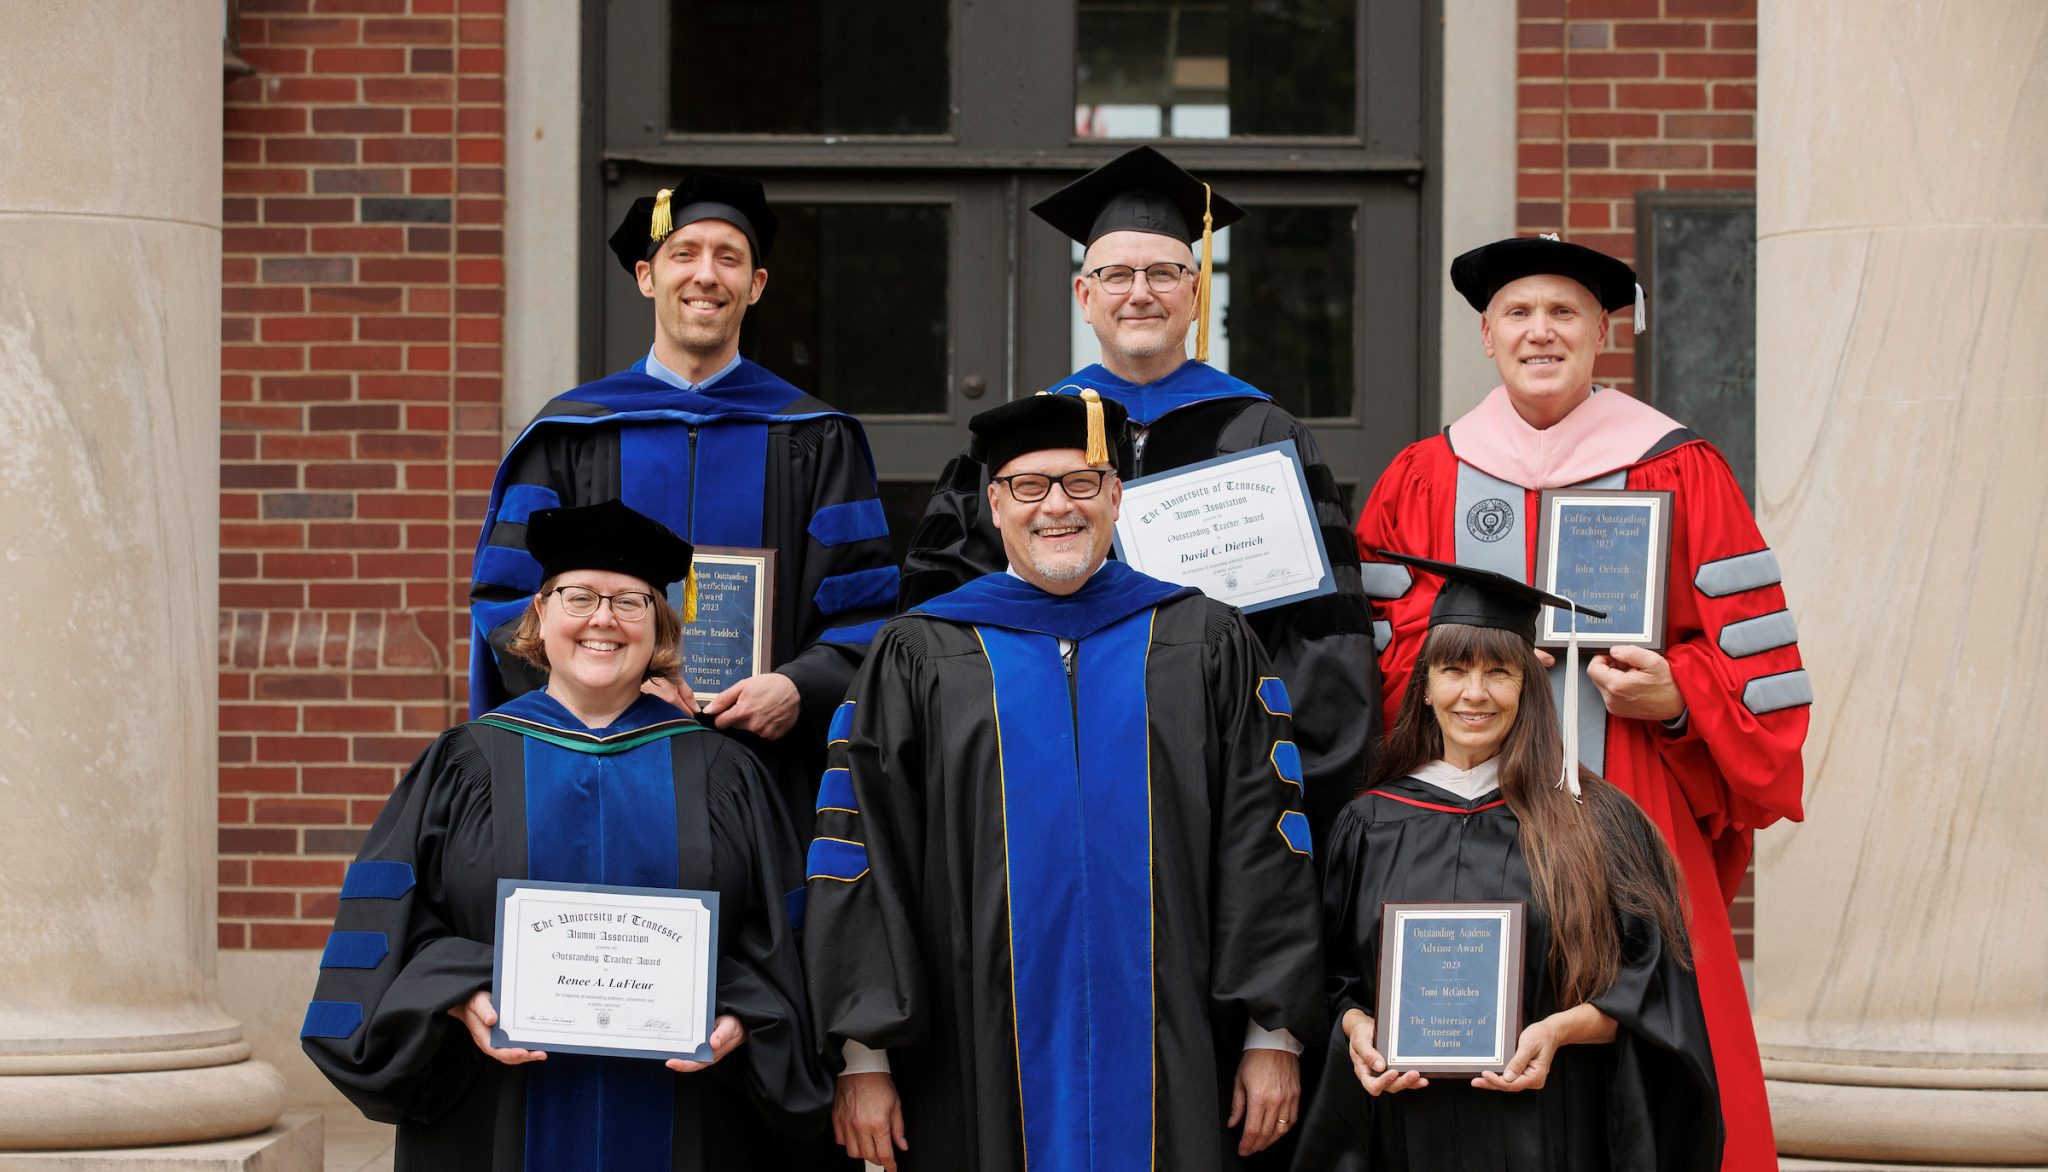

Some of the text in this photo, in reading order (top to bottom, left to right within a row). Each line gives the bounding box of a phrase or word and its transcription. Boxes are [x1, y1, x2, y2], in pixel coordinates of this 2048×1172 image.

[1140, 481, 1276, 524] The University of Tennessee
[1174, 507, 1200, 521] Alumni
[1203, 496, 1248, 513] Association
[1564, 513, 1647, 526] Coffey Outstanding
[1167, 513, 1265, 543] Outstanding Teacher Award
[1571, 526, 1640, 538] Teaching Award
[1181, 536, 1263, 563] David C. Dietrich
[1595, 540, 1614, 549] 2023
[1575, 564, 1594, 574] John
[714, 571, 749, 584] Outstanding
[698, 592, 723, 602] Award
[1583, 589, 1625, 600] University
[1630, 590, 1639, 599] of
[701, 602, 720, 611] 2023
[1618, 604, 1627, 612] at
[711, 627, 740, 639] Braddock
[691, 654, 731, 667] University
[735, 656, 745, 666] of
[684, 664, 733, 676] Tennessee at
[694, 676, 721, 686] Martin
[531, 912, 683, 944] The University of Tennessee
[1413, 927, 1493, 941] Outstanding Academic
[566, 929, 649, 944] Alumni Association
[1420, 943, 1484, 953] Advisor Award
[552, 951, 662, 967] Outstanding Teacher Award
[1441, 961, 1461, 969] 2023
[557, 974, 654, 991] Renee A. LaFleur
[1420, 986, 1480, 997] Tomi McCutchen
[1409, 1015, 1488, 1027] The University of
[1422, 1028, 1474, 1037] Tennessee at
[1433, 1039, 1461, 1049] Martin
